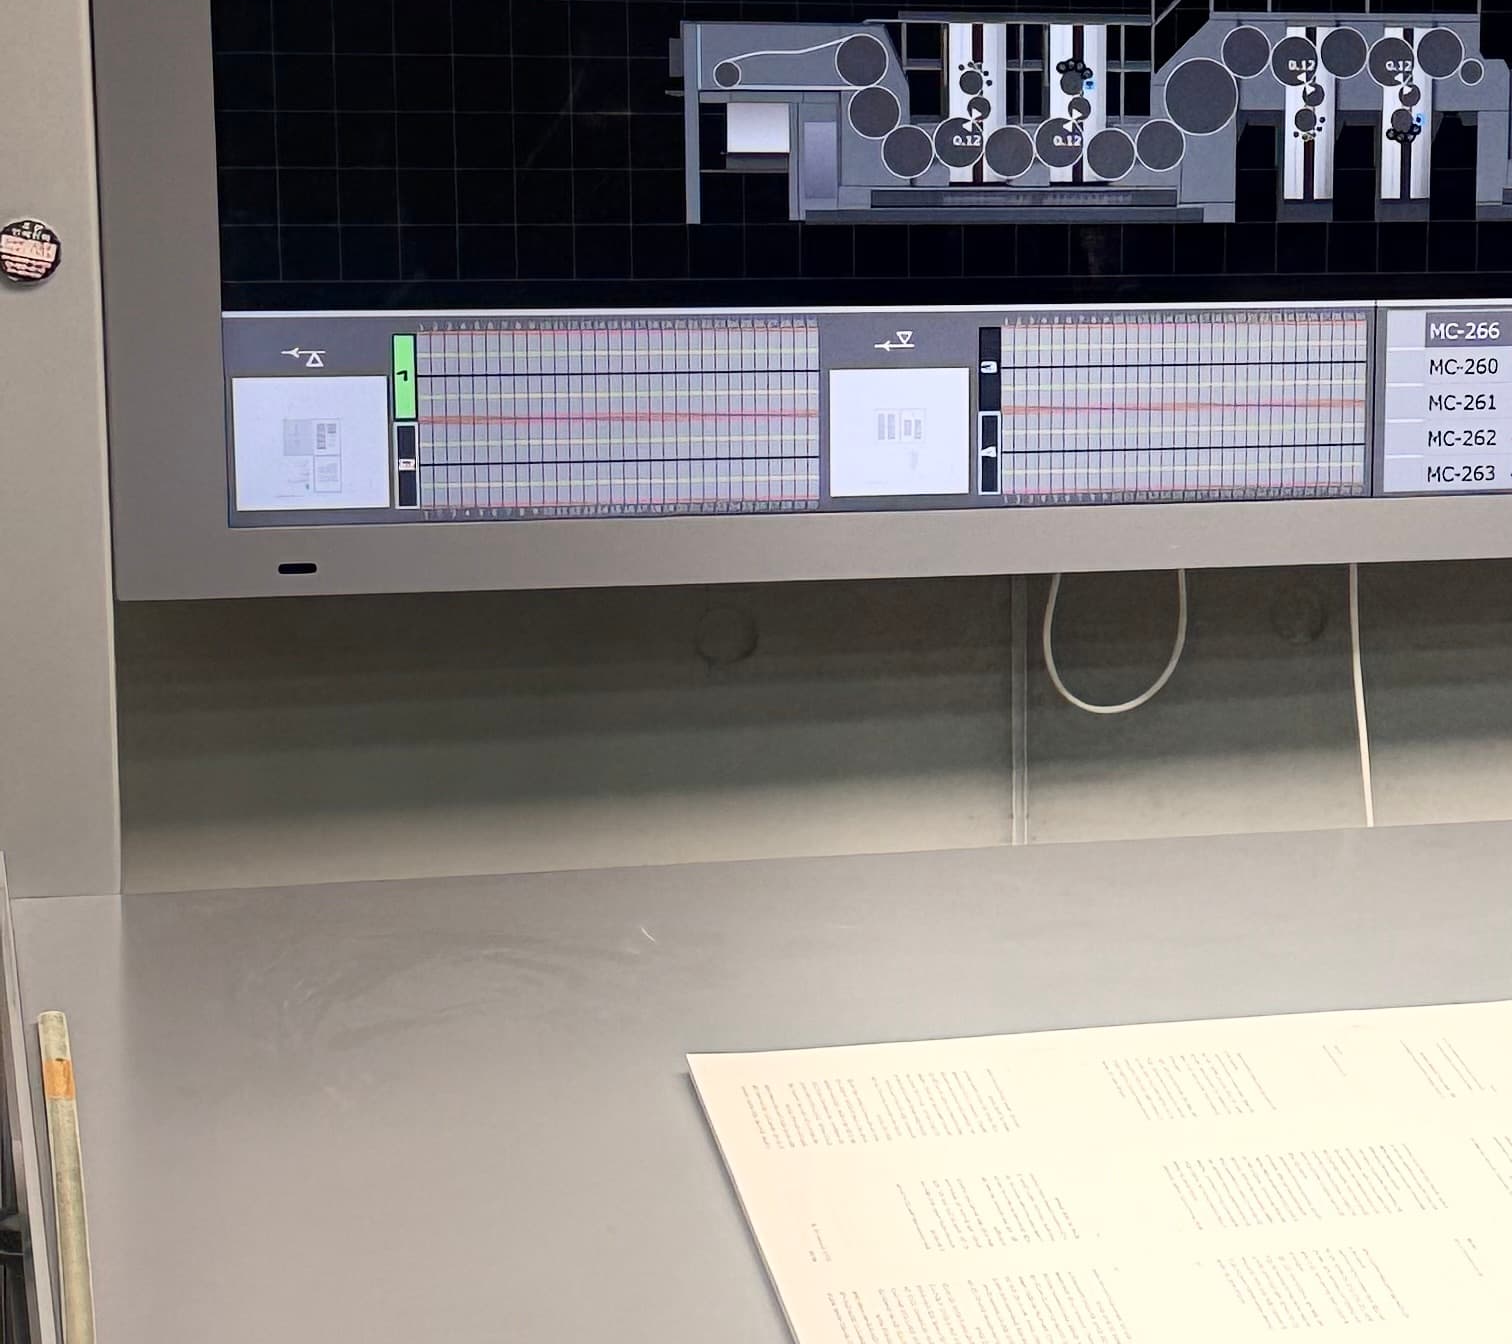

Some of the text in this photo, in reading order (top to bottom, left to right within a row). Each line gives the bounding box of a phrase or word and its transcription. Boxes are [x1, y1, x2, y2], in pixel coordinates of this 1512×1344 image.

[1430, 322, 1500, 340] MC-266
[1429, 358, 1498, 375] MC-260
[1429, 394, 1497, 411] MC-261
[1428, 429, 1497, 447] MC-262
[1427, 465, 1495, 483] MC-263
